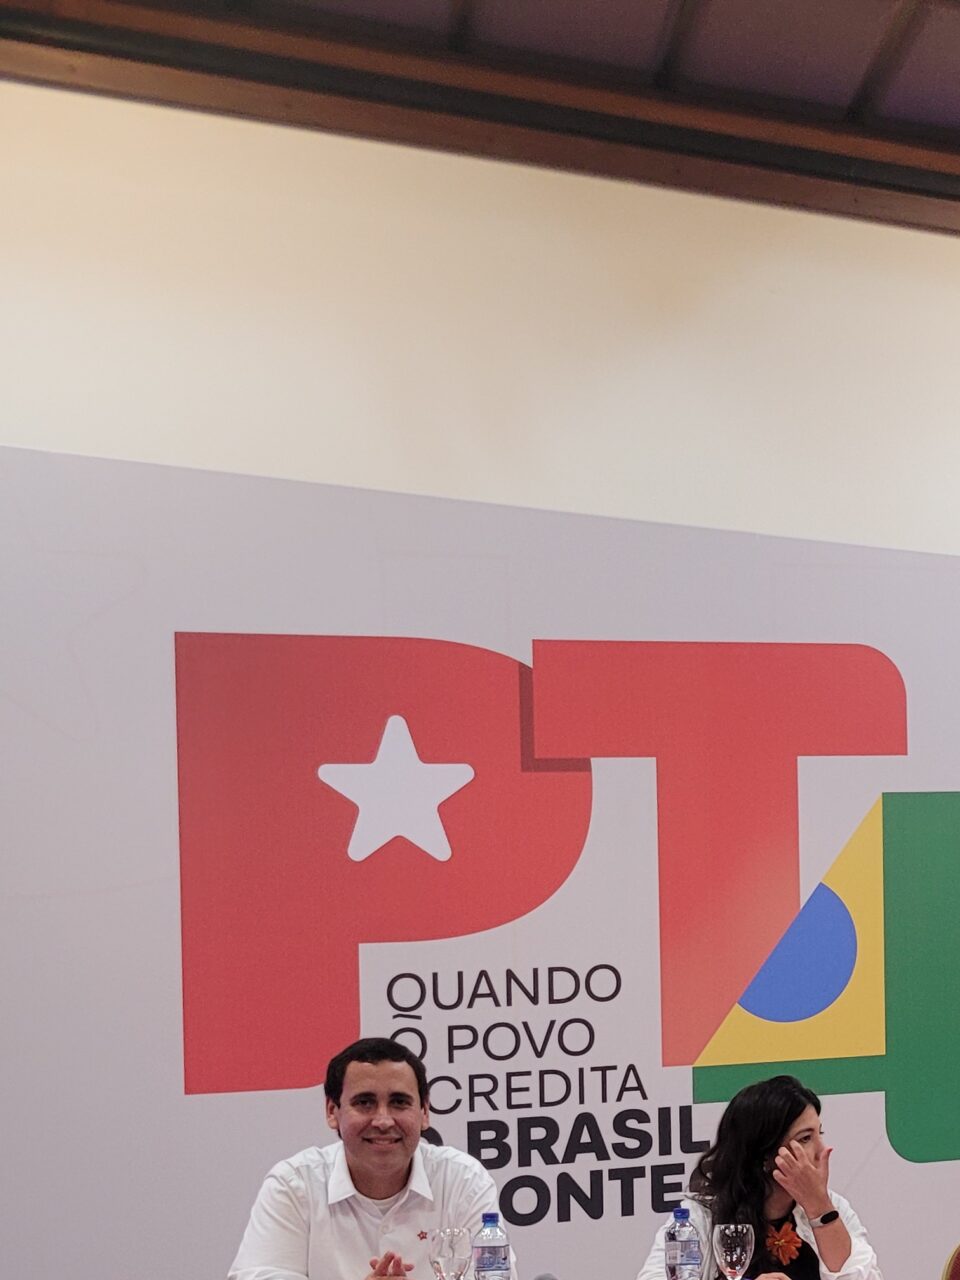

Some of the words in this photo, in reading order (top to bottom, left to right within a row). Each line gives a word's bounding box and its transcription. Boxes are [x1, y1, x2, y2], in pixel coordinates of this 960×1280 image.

[175, 632, 907, 1095] PT
[387, 964, 622, 1019] QUANDO
[448, 1018, 595, 1064] POVO
[427, 1064, 648, 1115] CREDITA
[467, 1105, 711, 1170] BRASIL
[499, 1163, 686, 1226] ONTE
